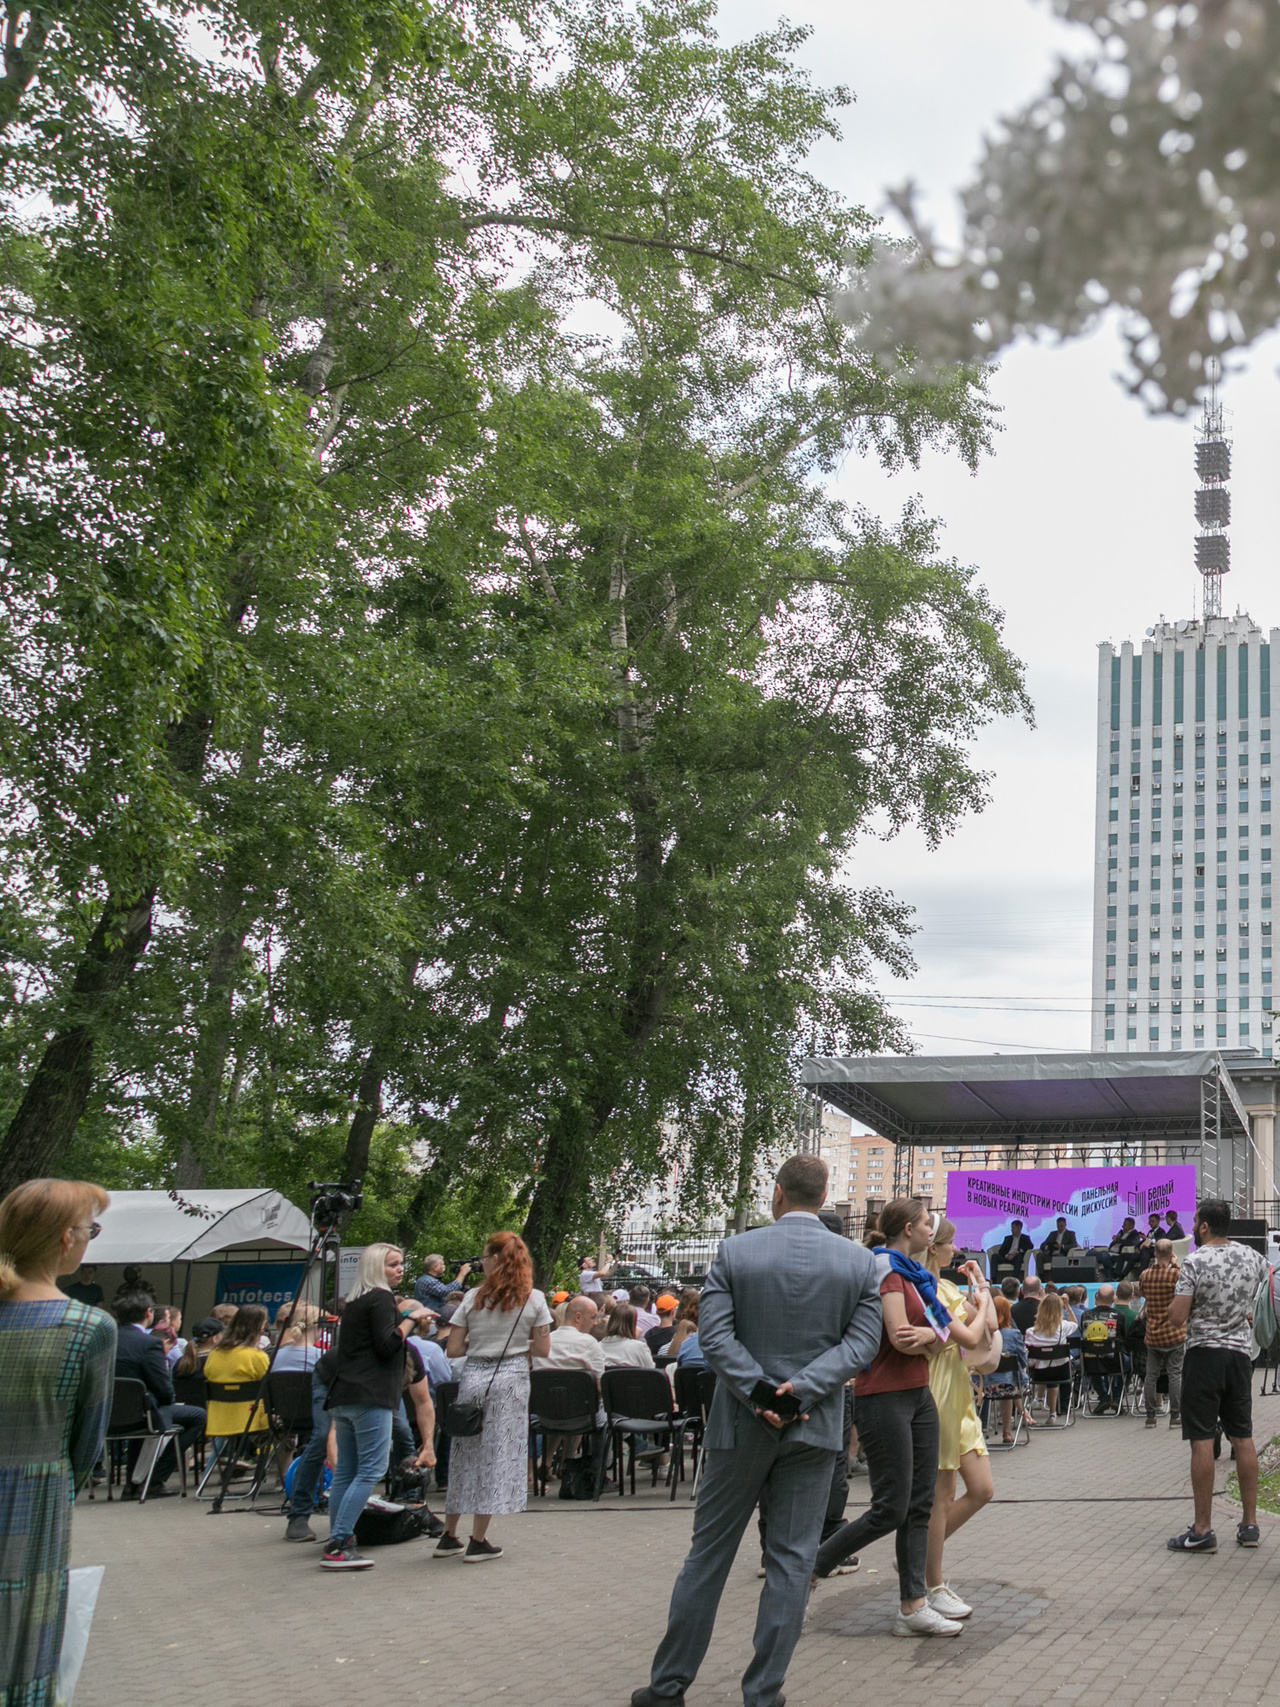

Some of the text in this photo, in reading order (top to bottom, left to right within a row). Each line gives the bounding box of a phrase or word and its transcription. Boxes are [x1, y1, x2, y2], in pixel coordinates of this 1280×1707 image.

[967, 1177, 1079, 1216] КРЕАТИВНЫЕ ИНДУСТРИИ РОССИИ
[1082, 1181, 1118, 1202] ПАНЕЛЬНАЯ
[967, 1191, 1029, 1218] В НОВЫХ РЕАЛИЯХ
[1081, 1195, 1117, 1217] ДИСКУССИЯ
[223, 1289, 293, 1302] infotecs
